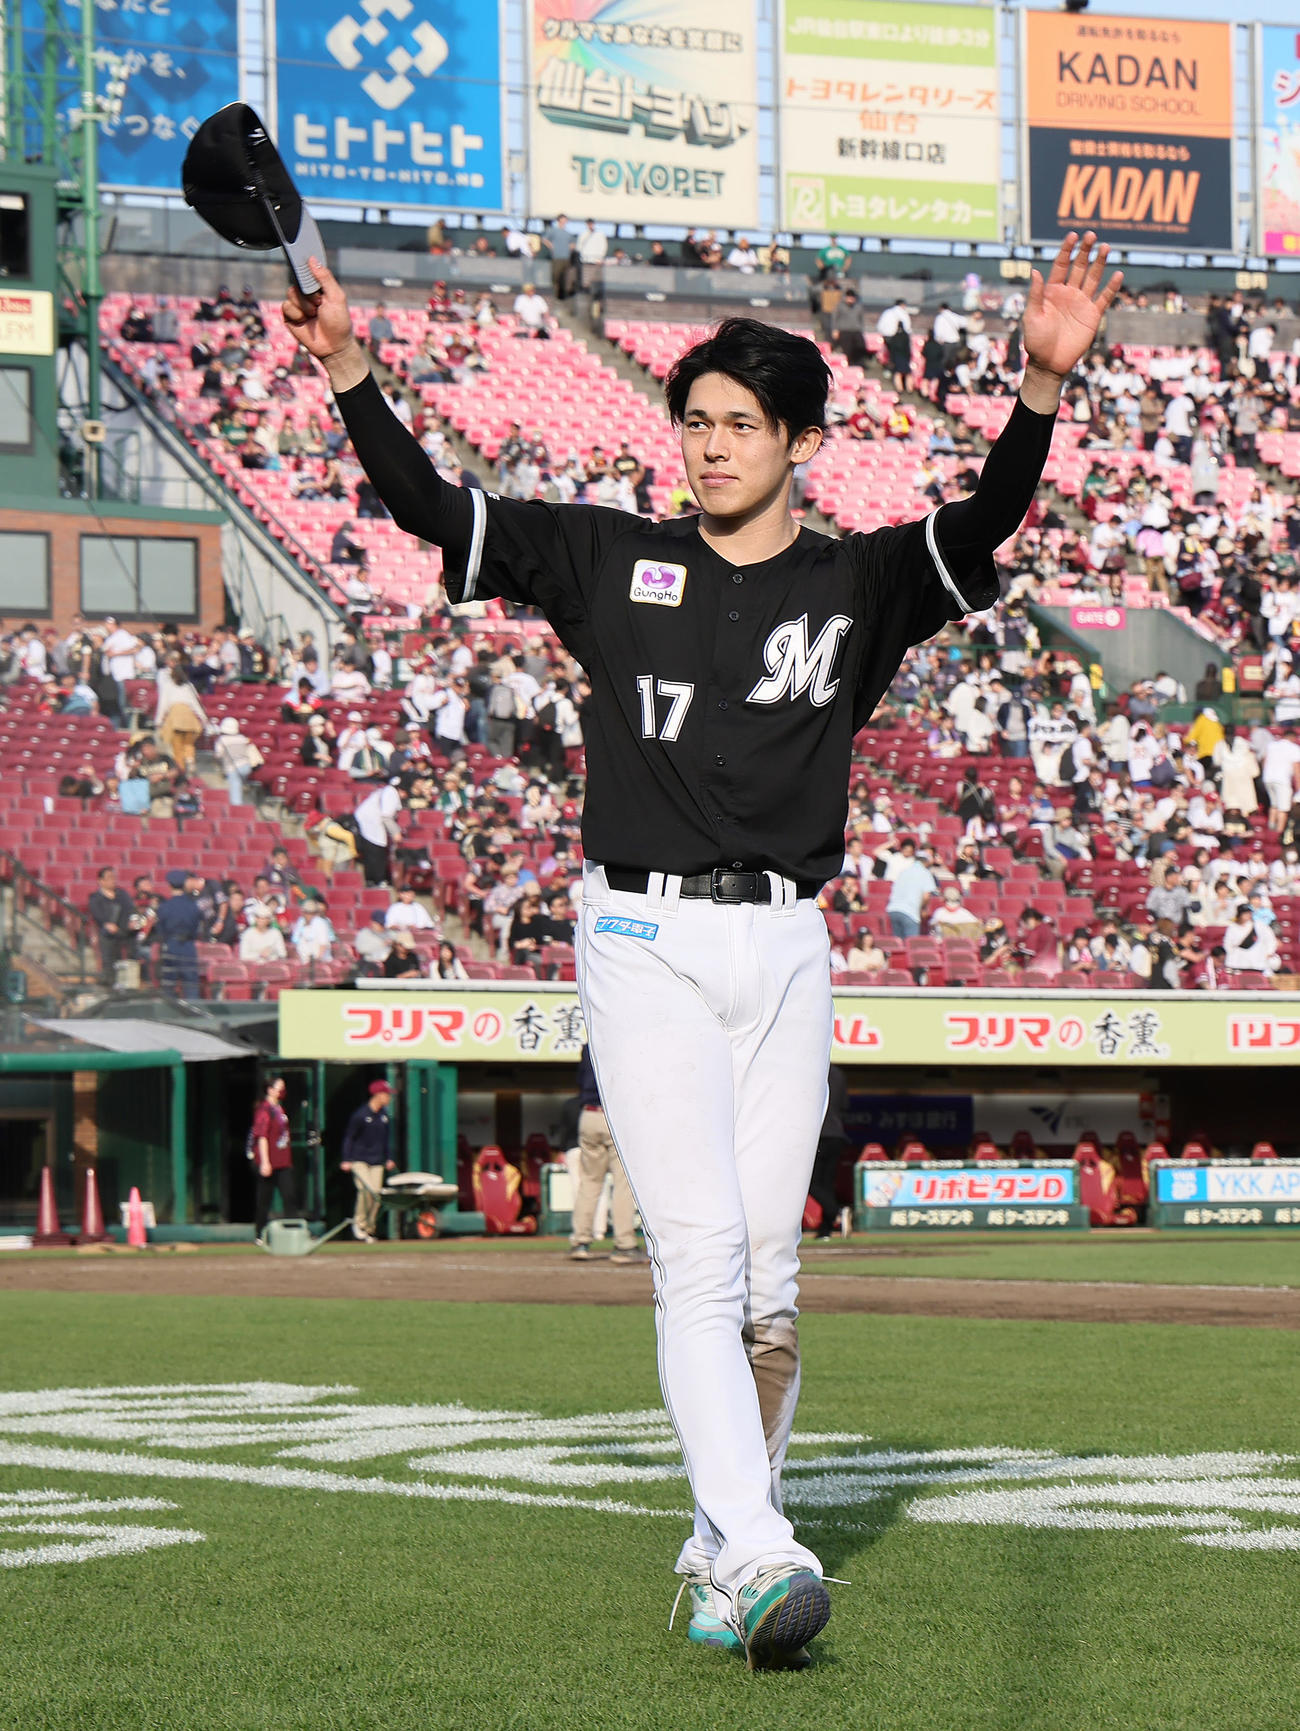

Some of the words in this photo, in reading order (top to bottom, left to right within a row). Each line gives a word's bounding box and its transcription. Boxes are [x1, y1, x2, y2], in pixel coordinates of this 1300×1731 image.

[1058, 51, 1198, 91] KADAN
[786, 77, 996, 111] トヨタレンタリース
[1056, 91, 1126, 111] DRIVING
[1131, 96, 1201, 116] SCHOOL
[859, 109, 918, 134] 仙台
[294, 113, 484, 168] ヒトトヒト
[838, 137, 946, 164] 新幹線口店
[572, 154, 725, 197] TOYOPET
[829, 192, 994, 225] トヨタレンタカー
[1057, 163, 1200, 224] KADAN
[634, 587, 678, 602] GungHo
[746, 612, 854, 708] M
[636, 674, 695, 742] 17
[947, 1012, 1161, 1056] プリマの香薫
[913, 1172, 1067, 1202] リポビタンD
[1215, 1173, 1263, 1196] YKK
